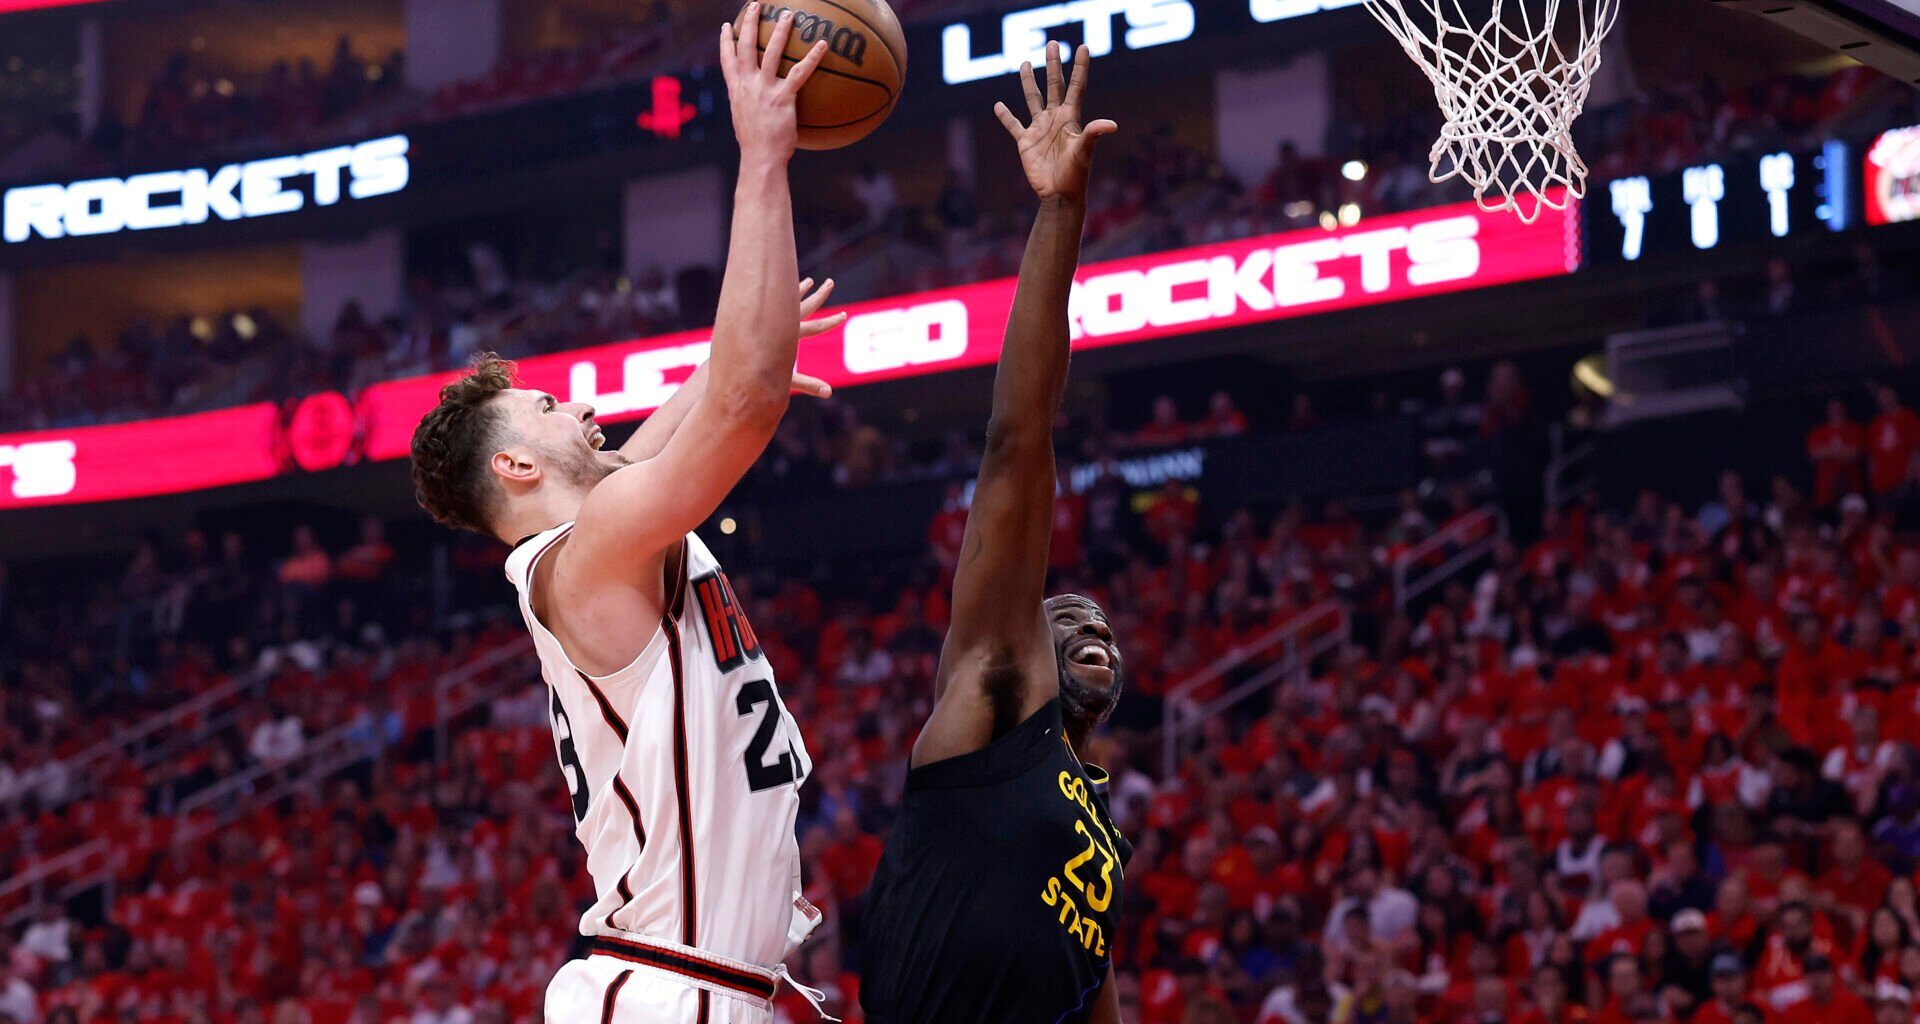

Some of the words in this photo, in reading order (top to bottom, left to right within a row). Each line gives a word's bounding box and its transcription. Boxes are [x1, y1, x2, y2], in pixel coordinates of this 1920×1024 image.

[942, 0, 1196, 84] LETS
[4, 134, 409, 242] ROCKETS
[843, 299, 968, 374] GO
[1064, 819, 1114, 913] 23
[1041, 876, 1105, 958] STATE
